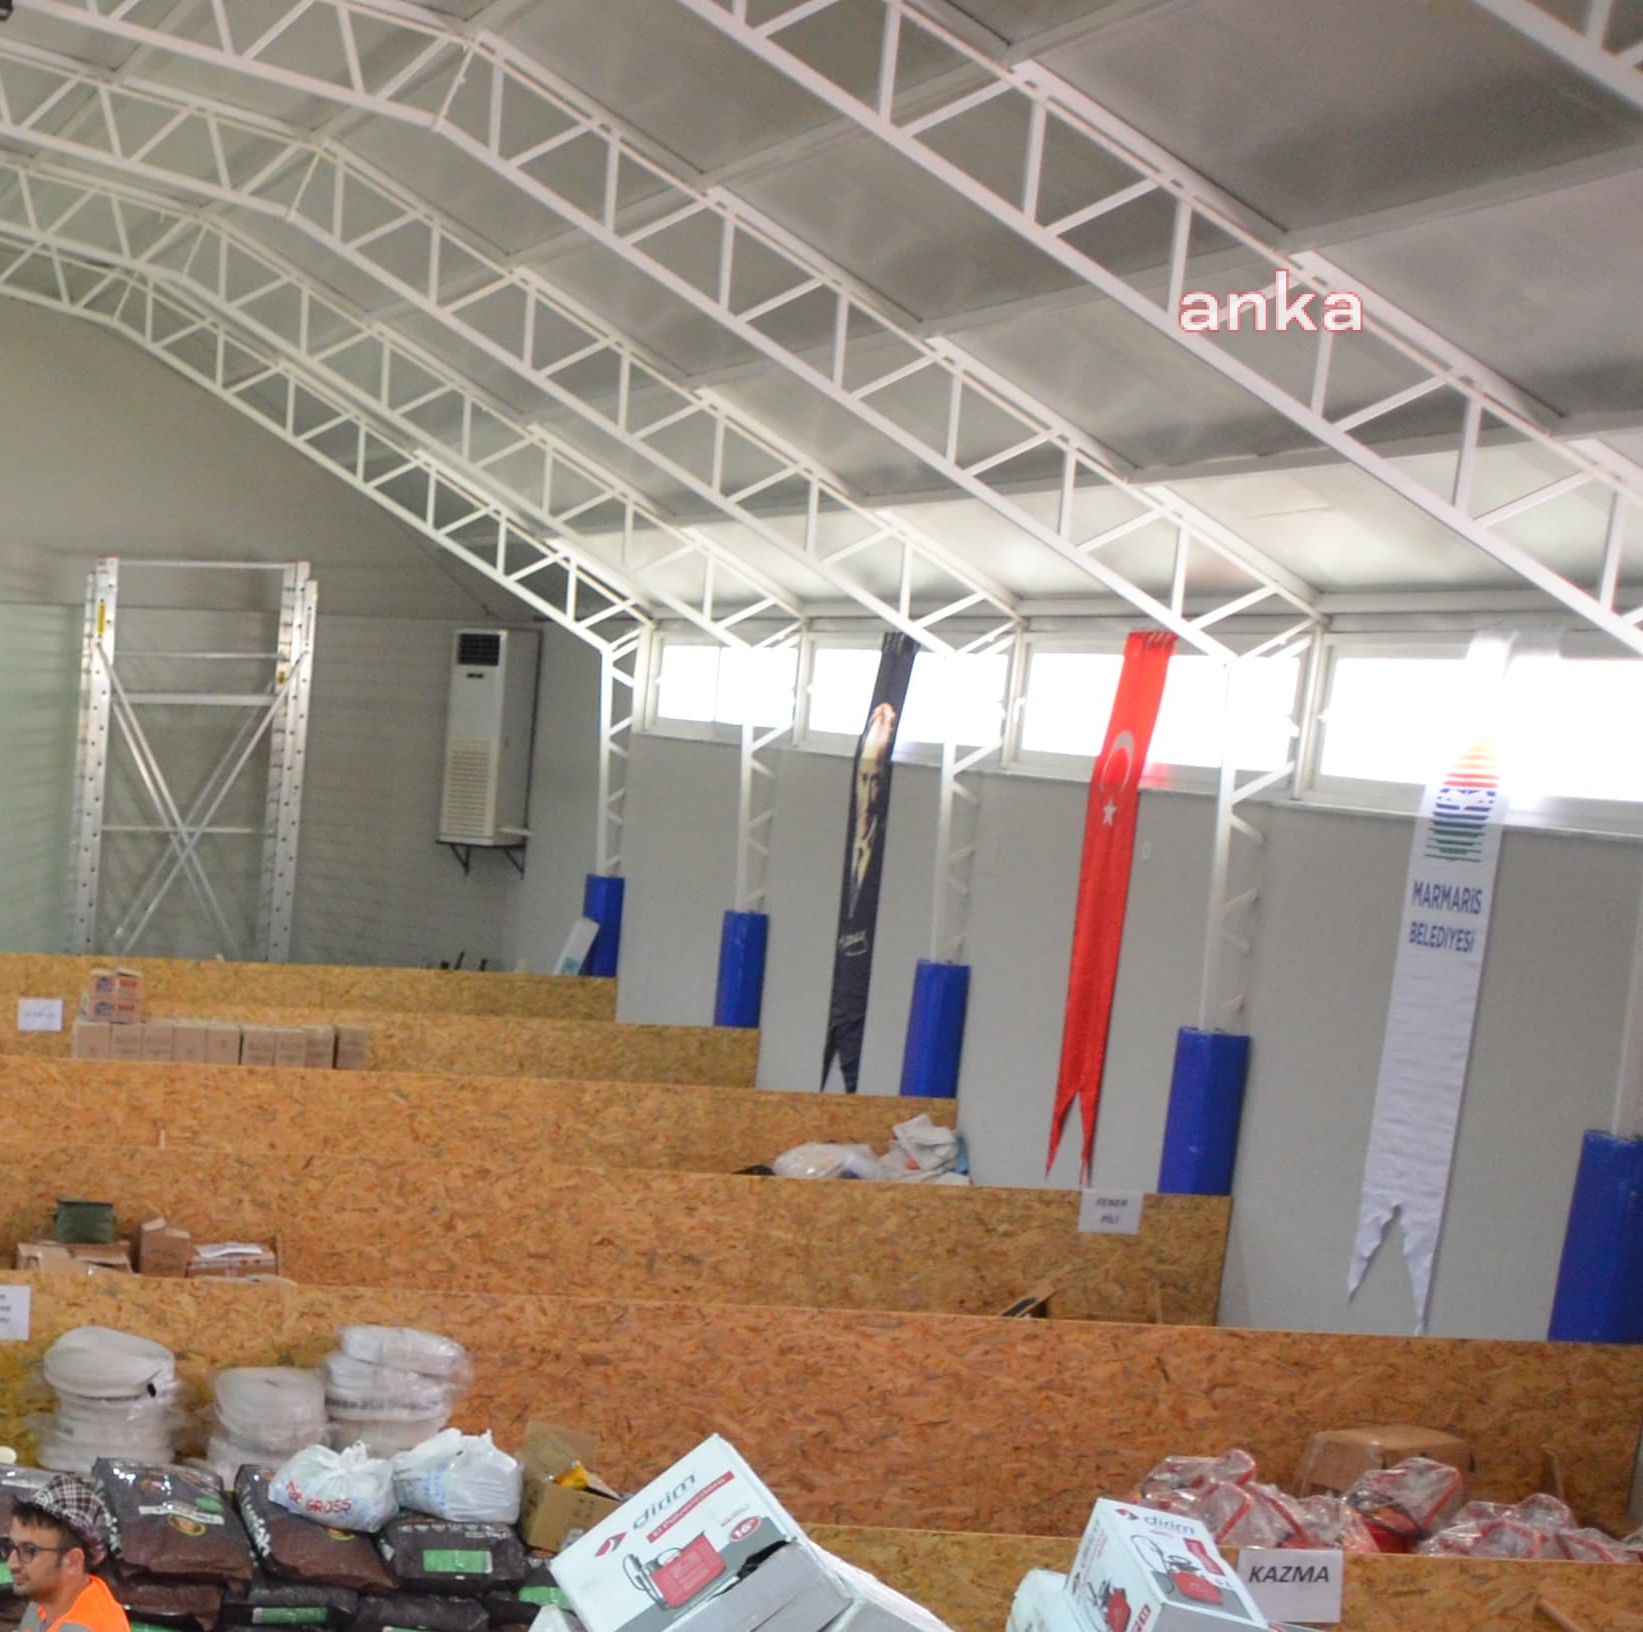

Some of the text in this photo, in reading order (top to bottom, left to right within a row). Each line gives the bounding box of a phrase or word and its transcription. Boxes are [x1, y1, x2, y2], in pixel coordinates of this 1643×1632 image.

[1411, 880, 1483, 915] MARMARİS
[1408, 921, 1475, 953] BELEDİYESİ
[632, 1473, 696, 1530] dirim
[1143, 1515, 1195, 1536] dirim
[1248, 1565, 1330, 1583] KAZMA
